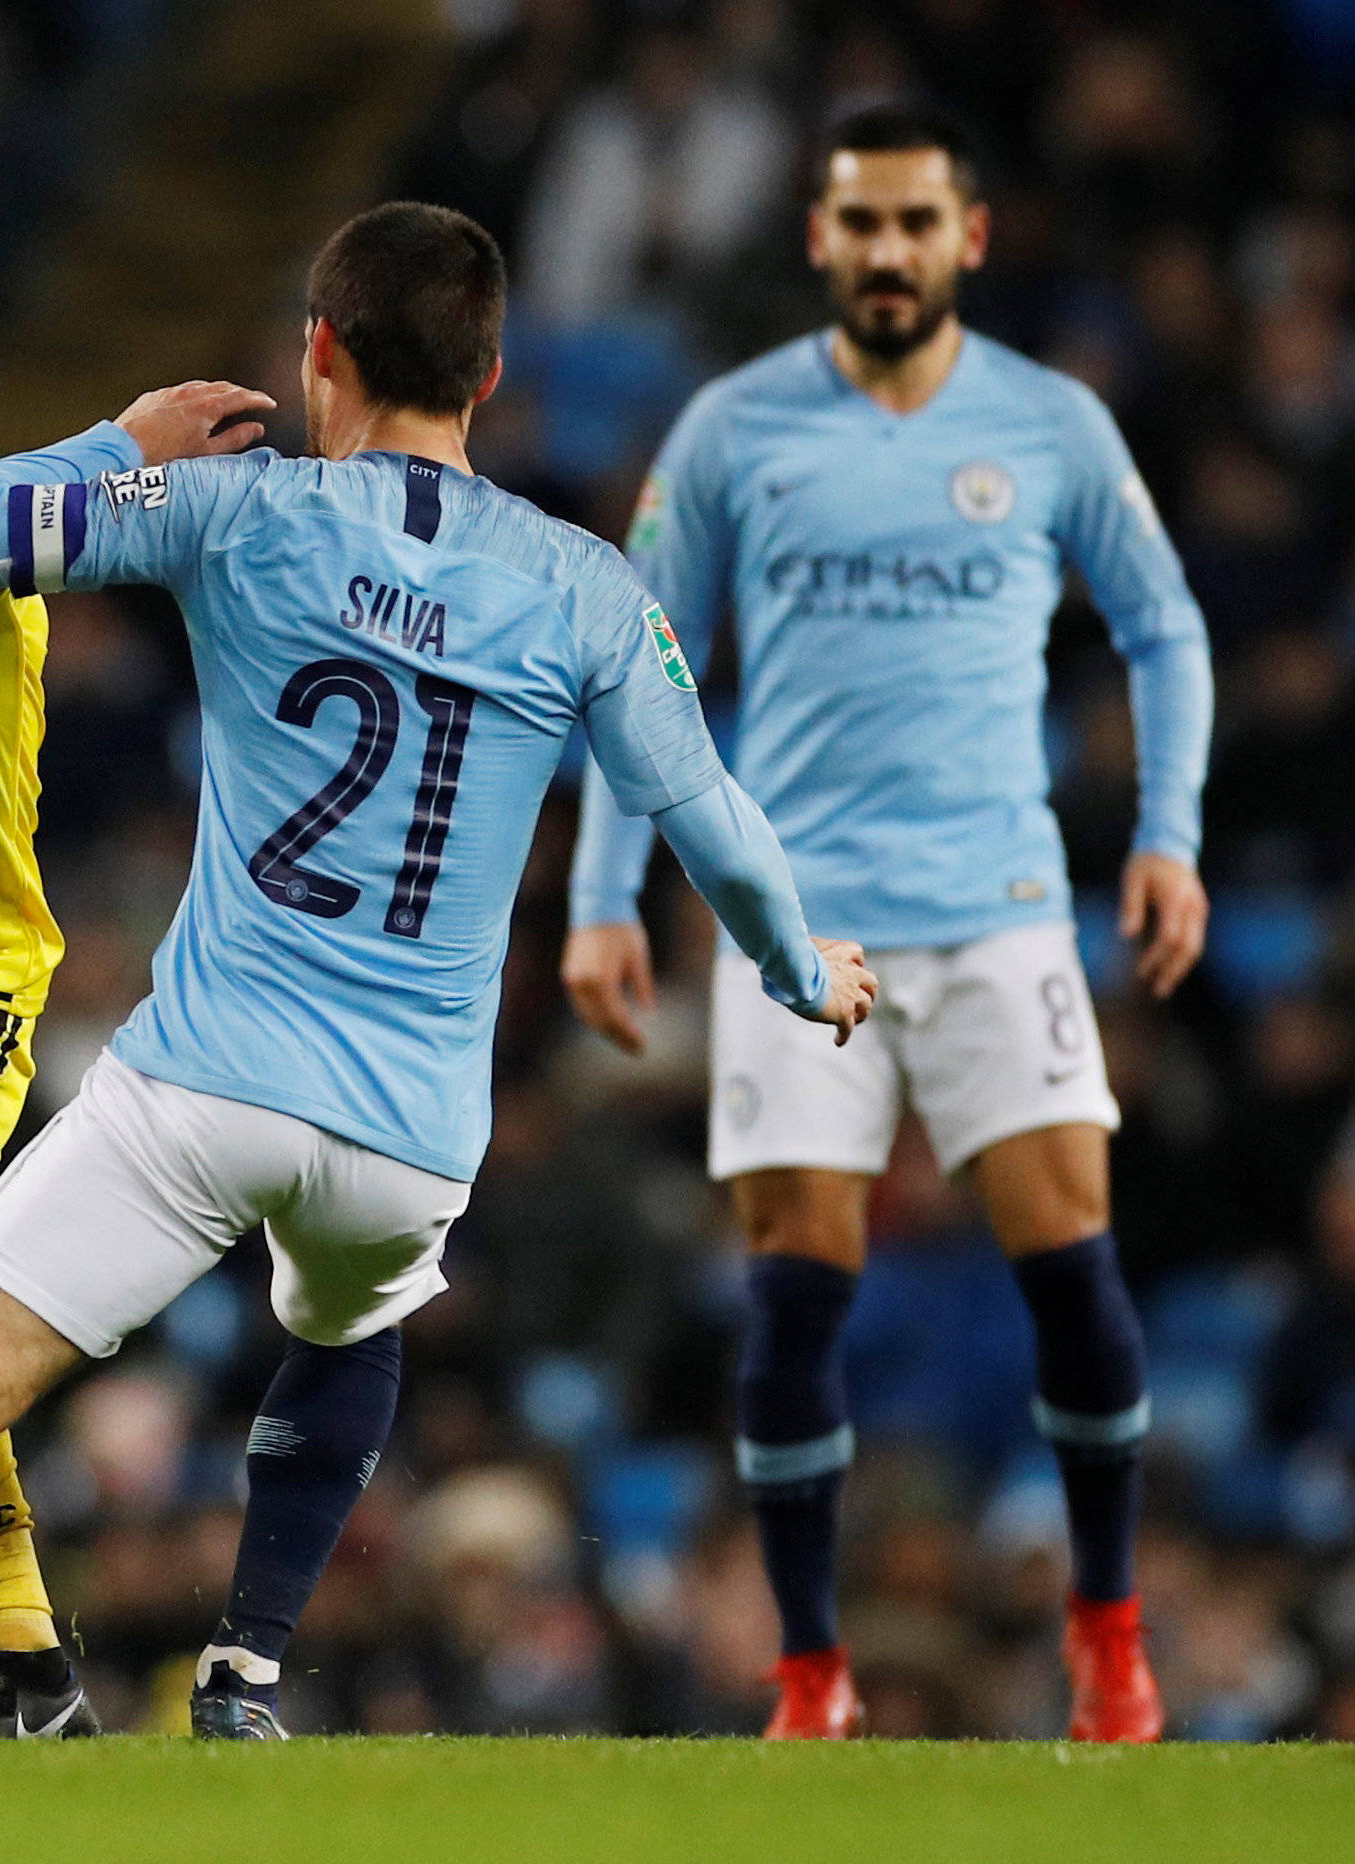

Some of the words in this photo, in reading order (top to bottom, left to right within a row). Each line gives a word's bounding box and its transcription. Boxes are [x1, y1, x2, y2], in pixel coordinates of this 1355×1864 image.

[410, 464, 439, 480] CITY
[340, 575, 445, 657] SILVA
[249, 658, 476, 938] 21
[1041, 973, 1083, 1055] 8
